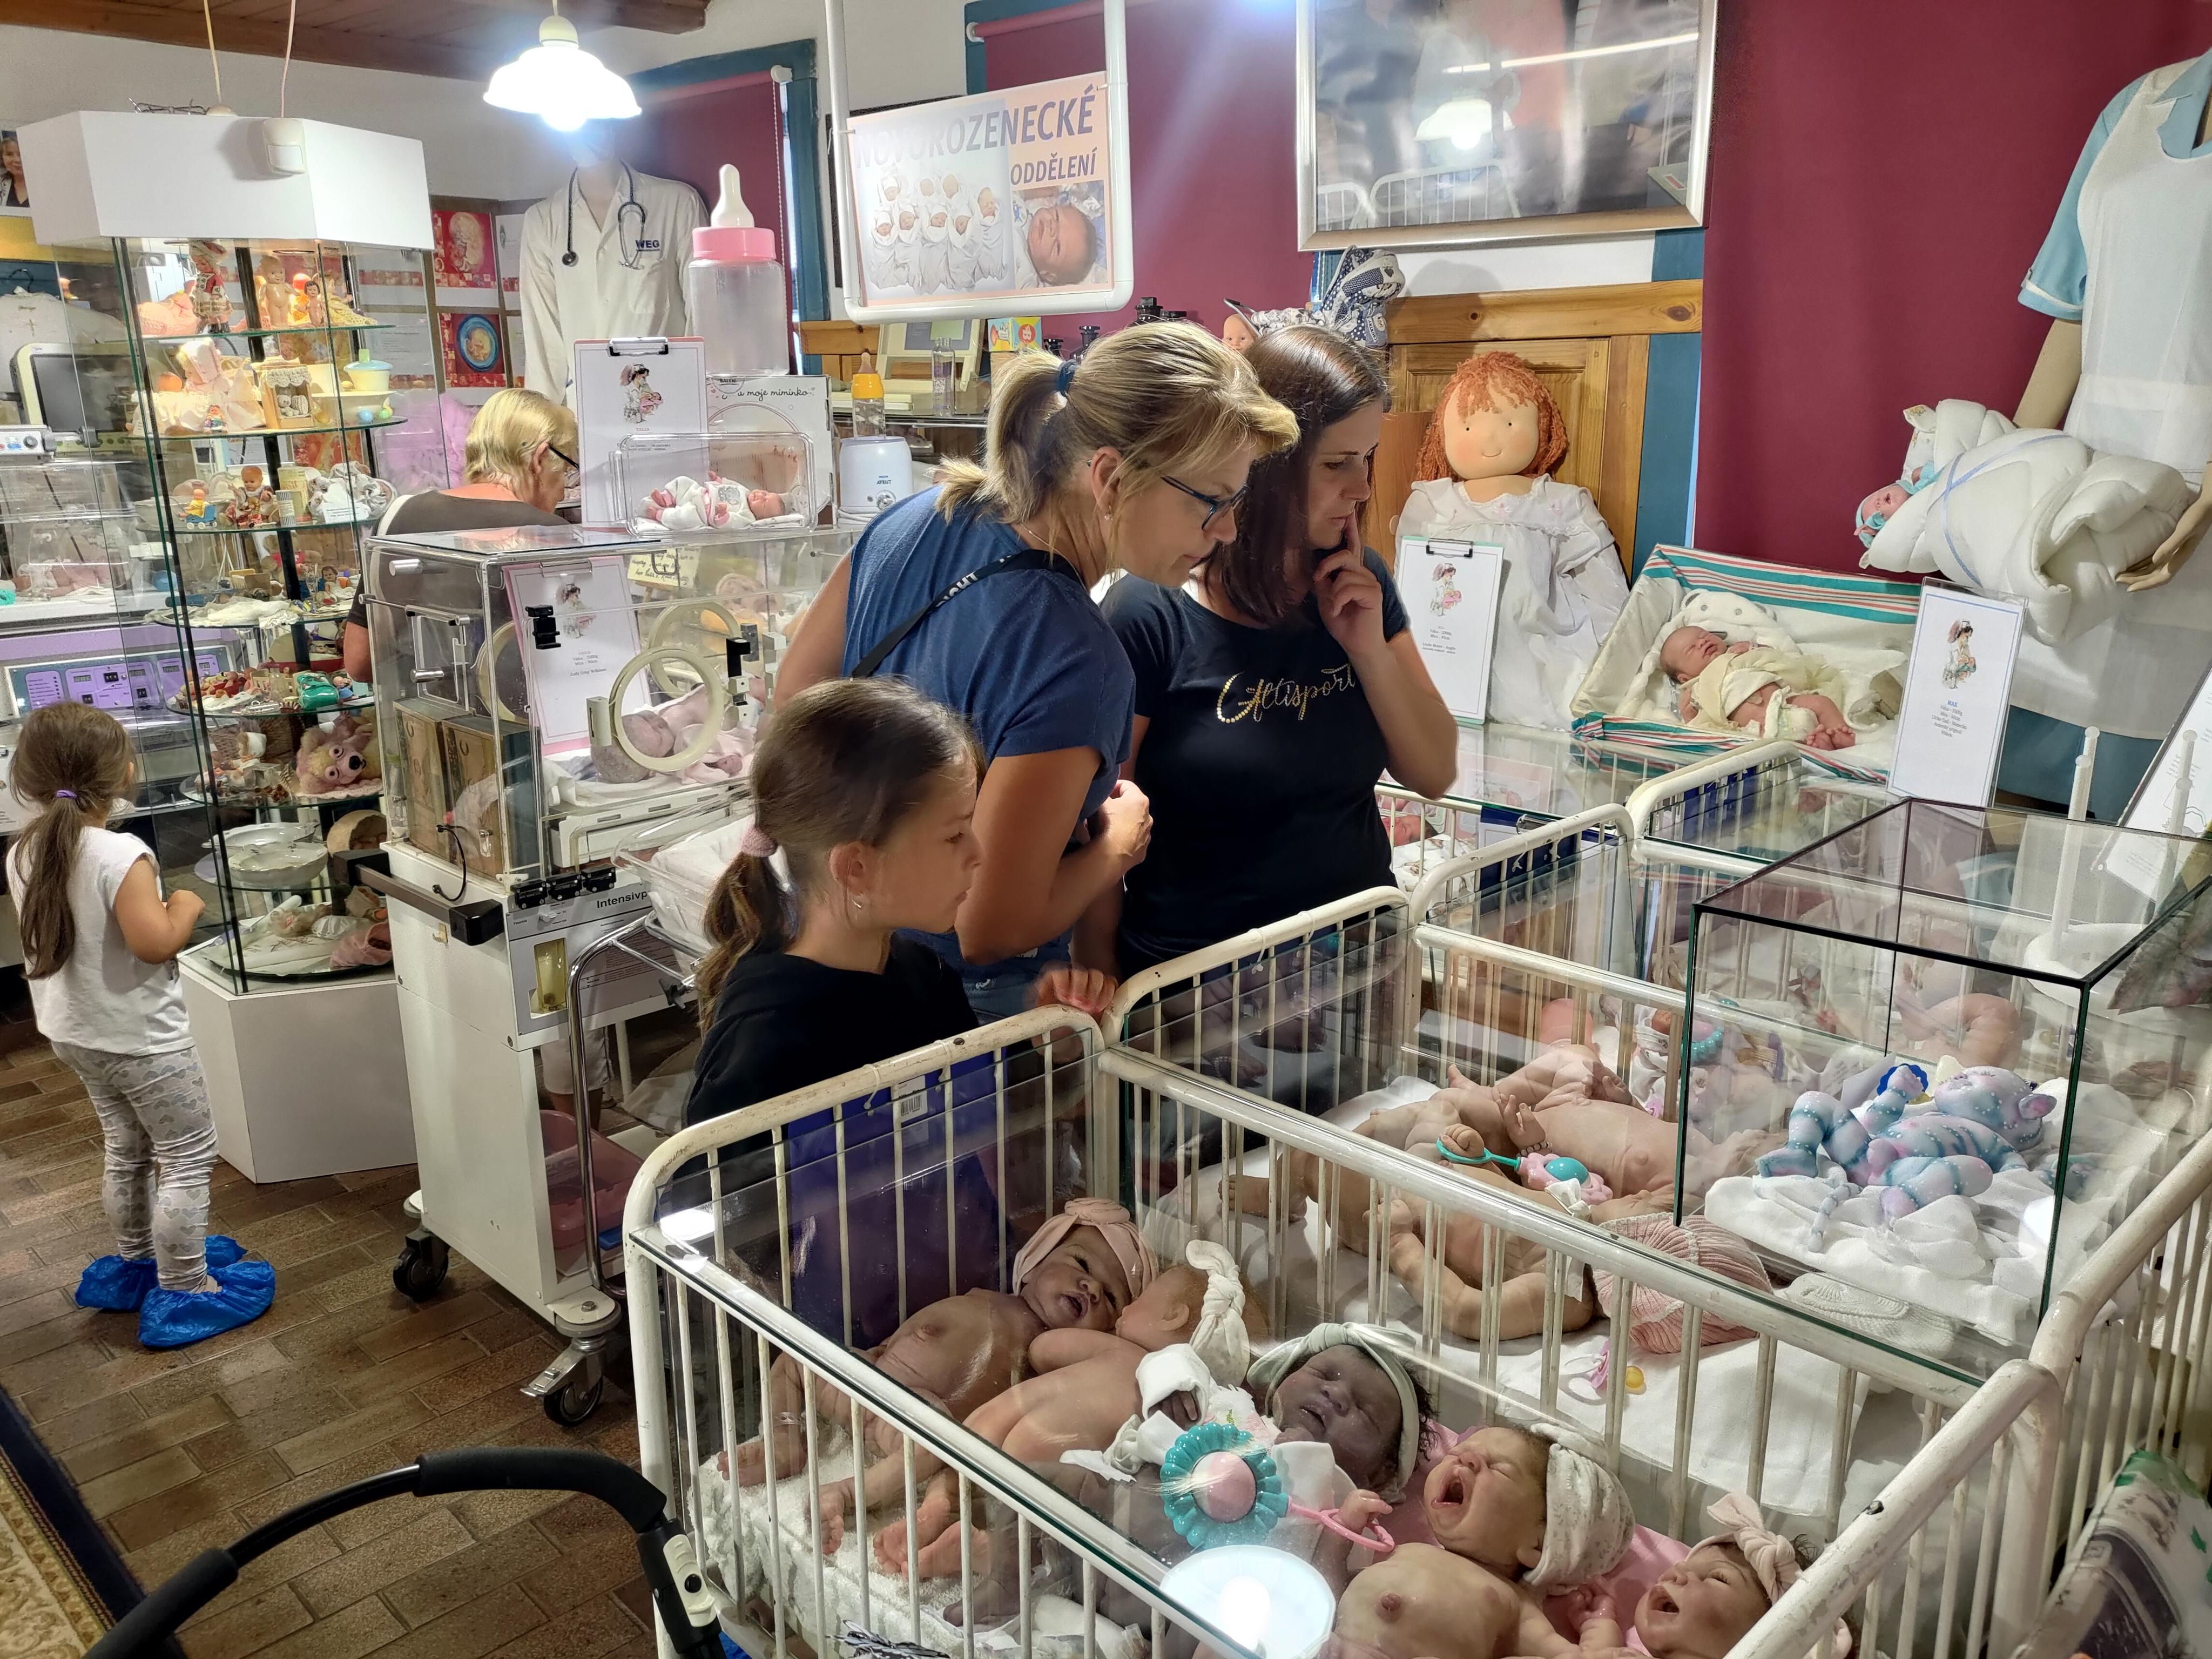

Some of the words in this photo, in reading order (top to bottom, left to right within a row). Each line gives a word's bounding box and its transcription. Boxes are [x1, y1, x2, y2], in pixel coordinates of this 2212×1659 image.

[857, 84, 1096, 168] NOVOROZENECKÉ
[1010, 146, 1097, 185] ODDĚLENÍ
[747, 389, 768, 402] moje
[771, 387, 809, 396] miminko
[596, 891, 648, 909] Intensivp
